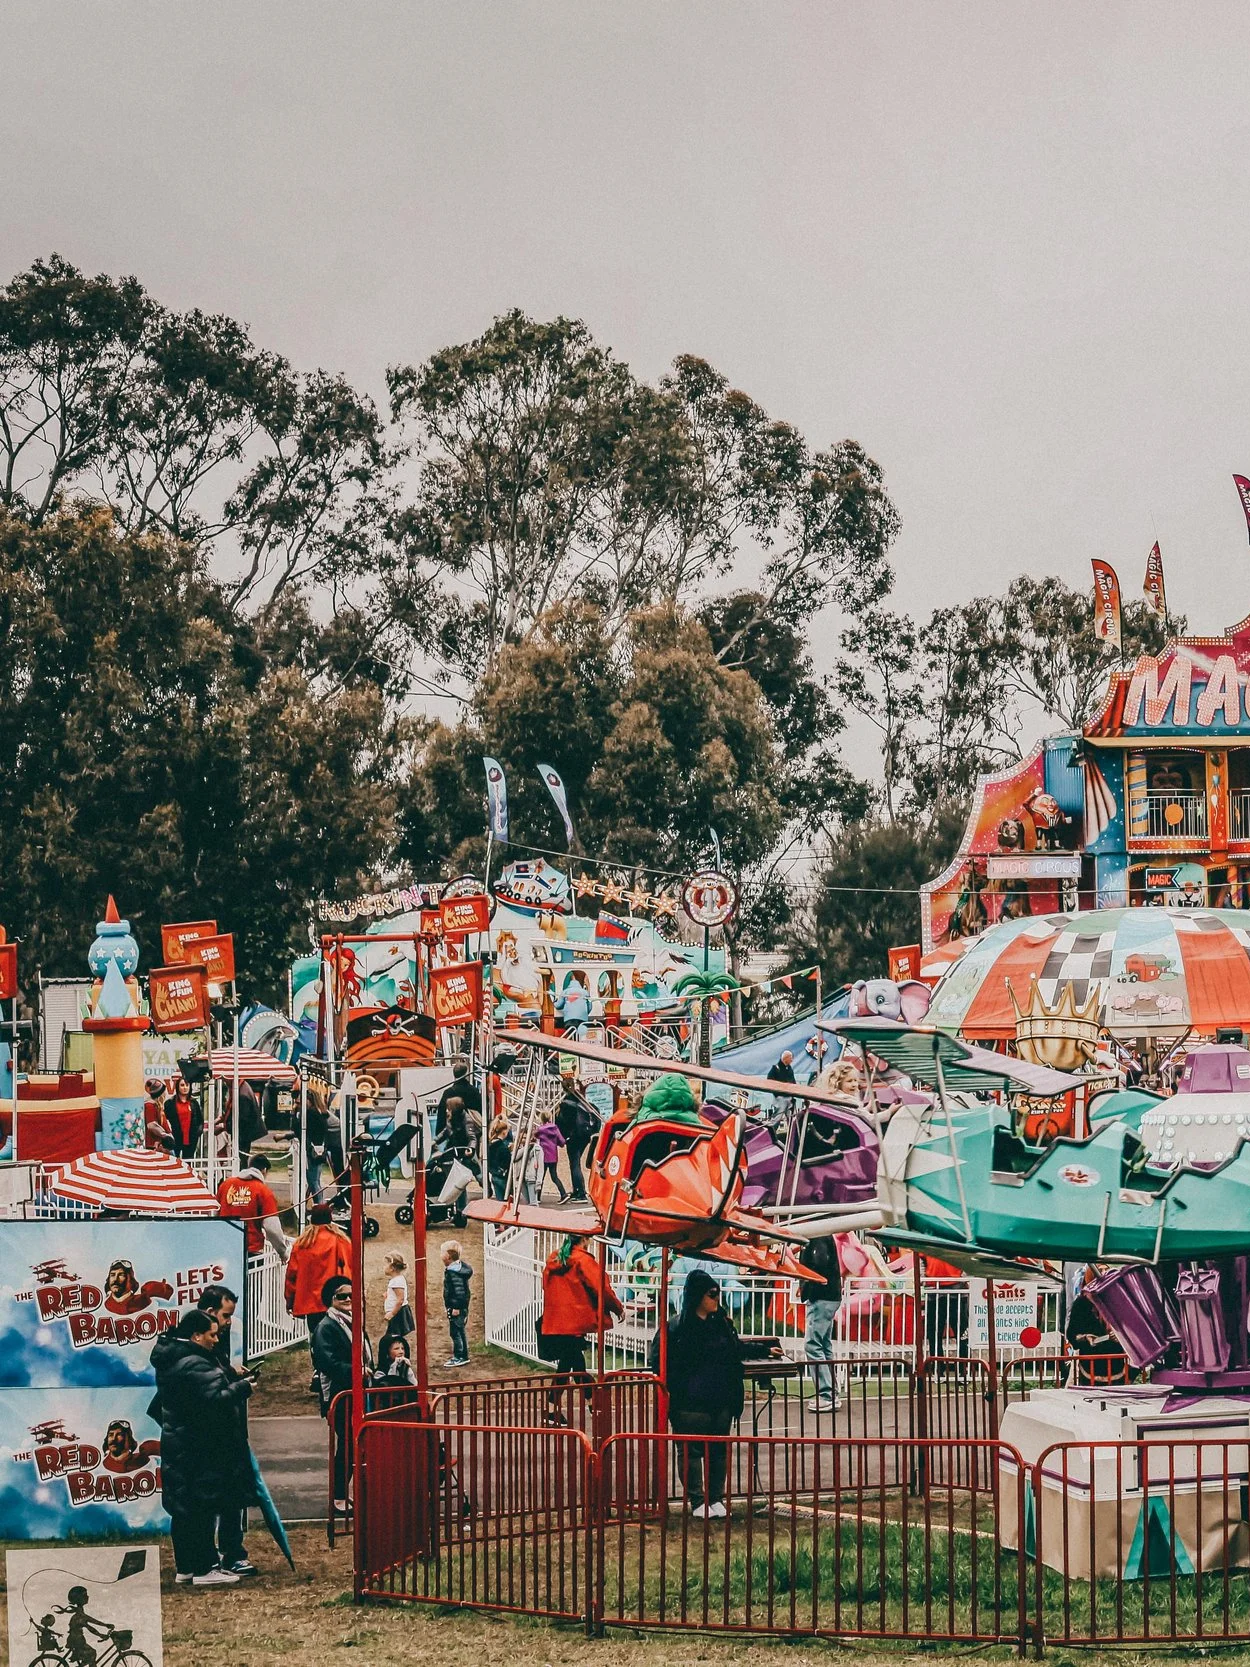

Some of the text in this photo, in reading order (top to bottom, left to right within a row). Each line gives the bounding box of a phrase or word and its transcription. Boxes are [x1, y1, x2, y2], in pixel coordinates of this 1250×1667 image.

[1095, 569, 1116, 636] MAGIC CIRCUS
[993, 861, 1080, 874] MAGIC CIRCUS
[1147, 874, 1172, 886] MAGIC
[444, 907, 478, 929] CHANTS
[168, 978, 191, 991] KING
[446, 976, 466, 989] KING
[176, 986, 193, 998] FUN
[435, 981, 473, 1016] CHANTS
[155, 982, 198, 1021] CHANTS
[176, 1264, 225, 1288] LET'S
[15, 1284, 104, 1321] THE RED
[974, 1305, 988, 1315] This
[1005, 1305, 1034, 1315] accepts
[68, 1309, 180, 1348] BARON
[977, 1318, 986, 1328] all
[1014, 1318, 1030, 1328] kids
[997, 1332, 1020, 1342] ticket
[13, 1444, 102, 1480] THE RED
